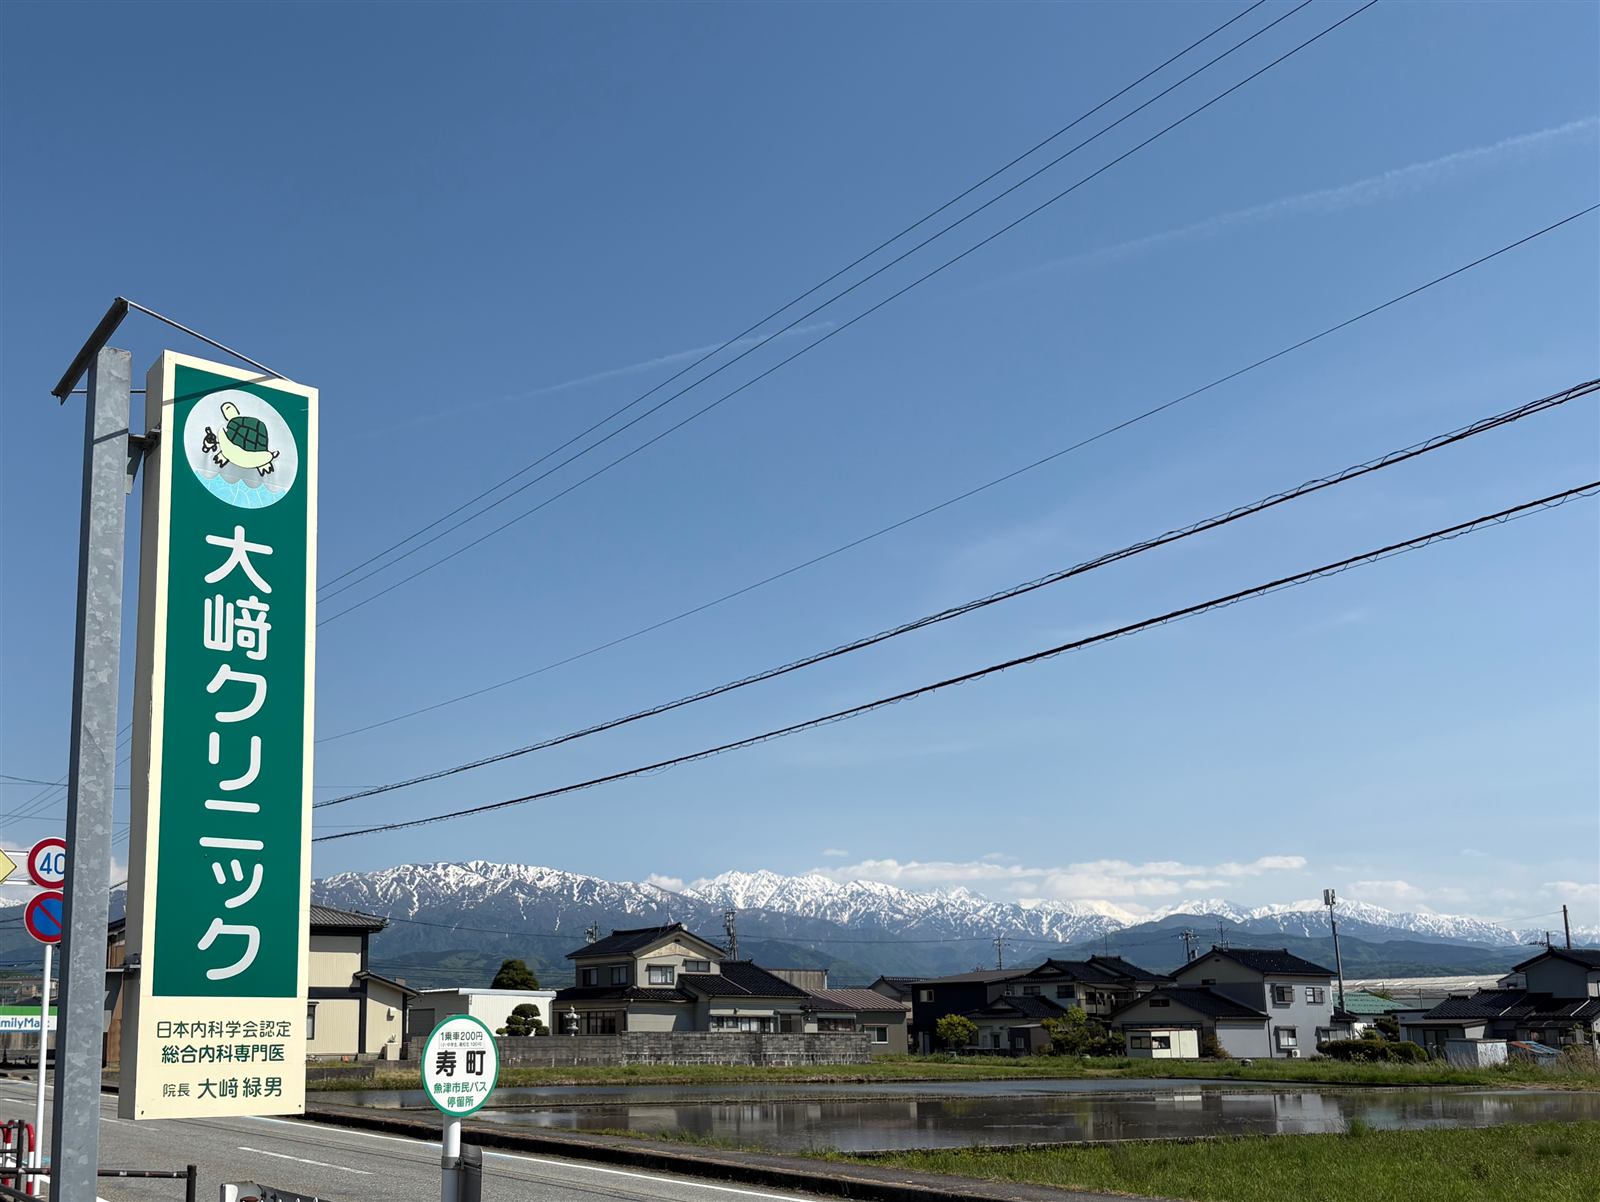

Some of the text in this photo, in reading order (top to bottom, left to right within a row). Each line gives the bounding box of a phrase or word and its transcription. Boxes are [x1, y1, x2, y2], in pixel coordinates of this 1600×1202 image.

[40, 852, 65, 875] 40
[157, 1020, 292, 1039] 日本内科学会認定
[440, 1031, 483, 1041] 1乗車200円
[161, 1044, 285, 1064] 総合内科専門医
[162, 1083, 190, 1098] 院長
[433, 1081, 487, 1094] 魚津市民バス
[447, 1096, 474, 1108] 停留所
